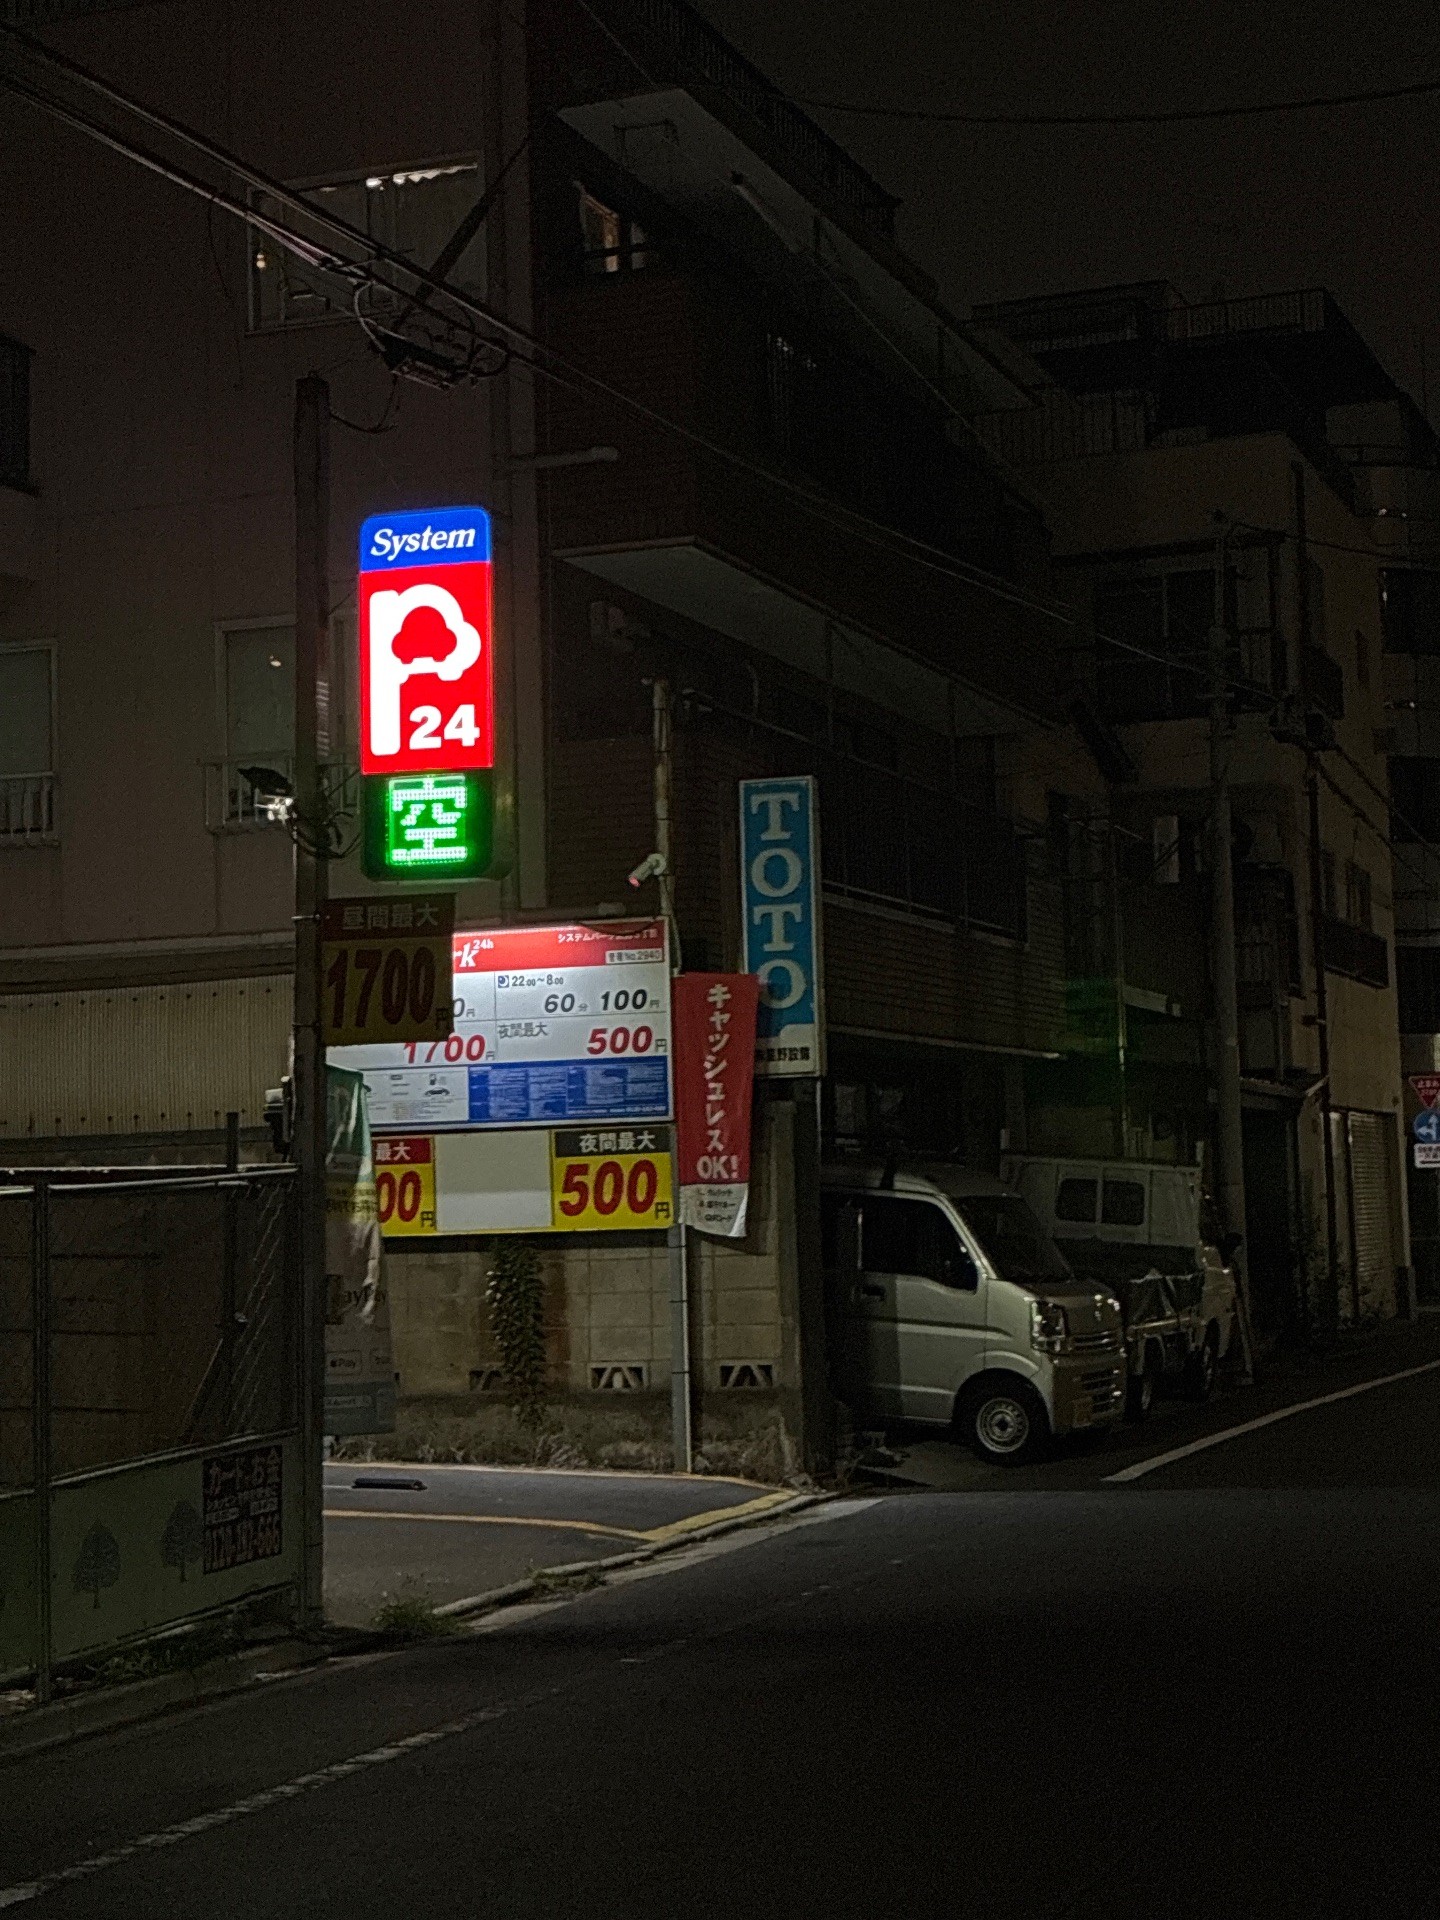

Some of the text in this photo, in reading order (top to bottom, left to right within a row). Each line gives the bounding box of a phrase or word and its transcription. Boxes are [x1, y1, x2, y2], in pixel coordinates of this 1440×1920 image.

[371, 526, 476, 561] System
[409, 704, 480, 750] 24
[391, 777, 468, 864] 空
[343, 902, 440, 930] 昼間最大
[751, 791, 807, 1010] TOTO
[498, 1021, 548, 1040] 夜間最大
[702, 983, 732, 1152] キャッシュレス
[375, 1141, 411, 1161] 最大
[579, 1131, 655, 1152] 夜間最大
[696, 1154, 738, 1180] OK!
